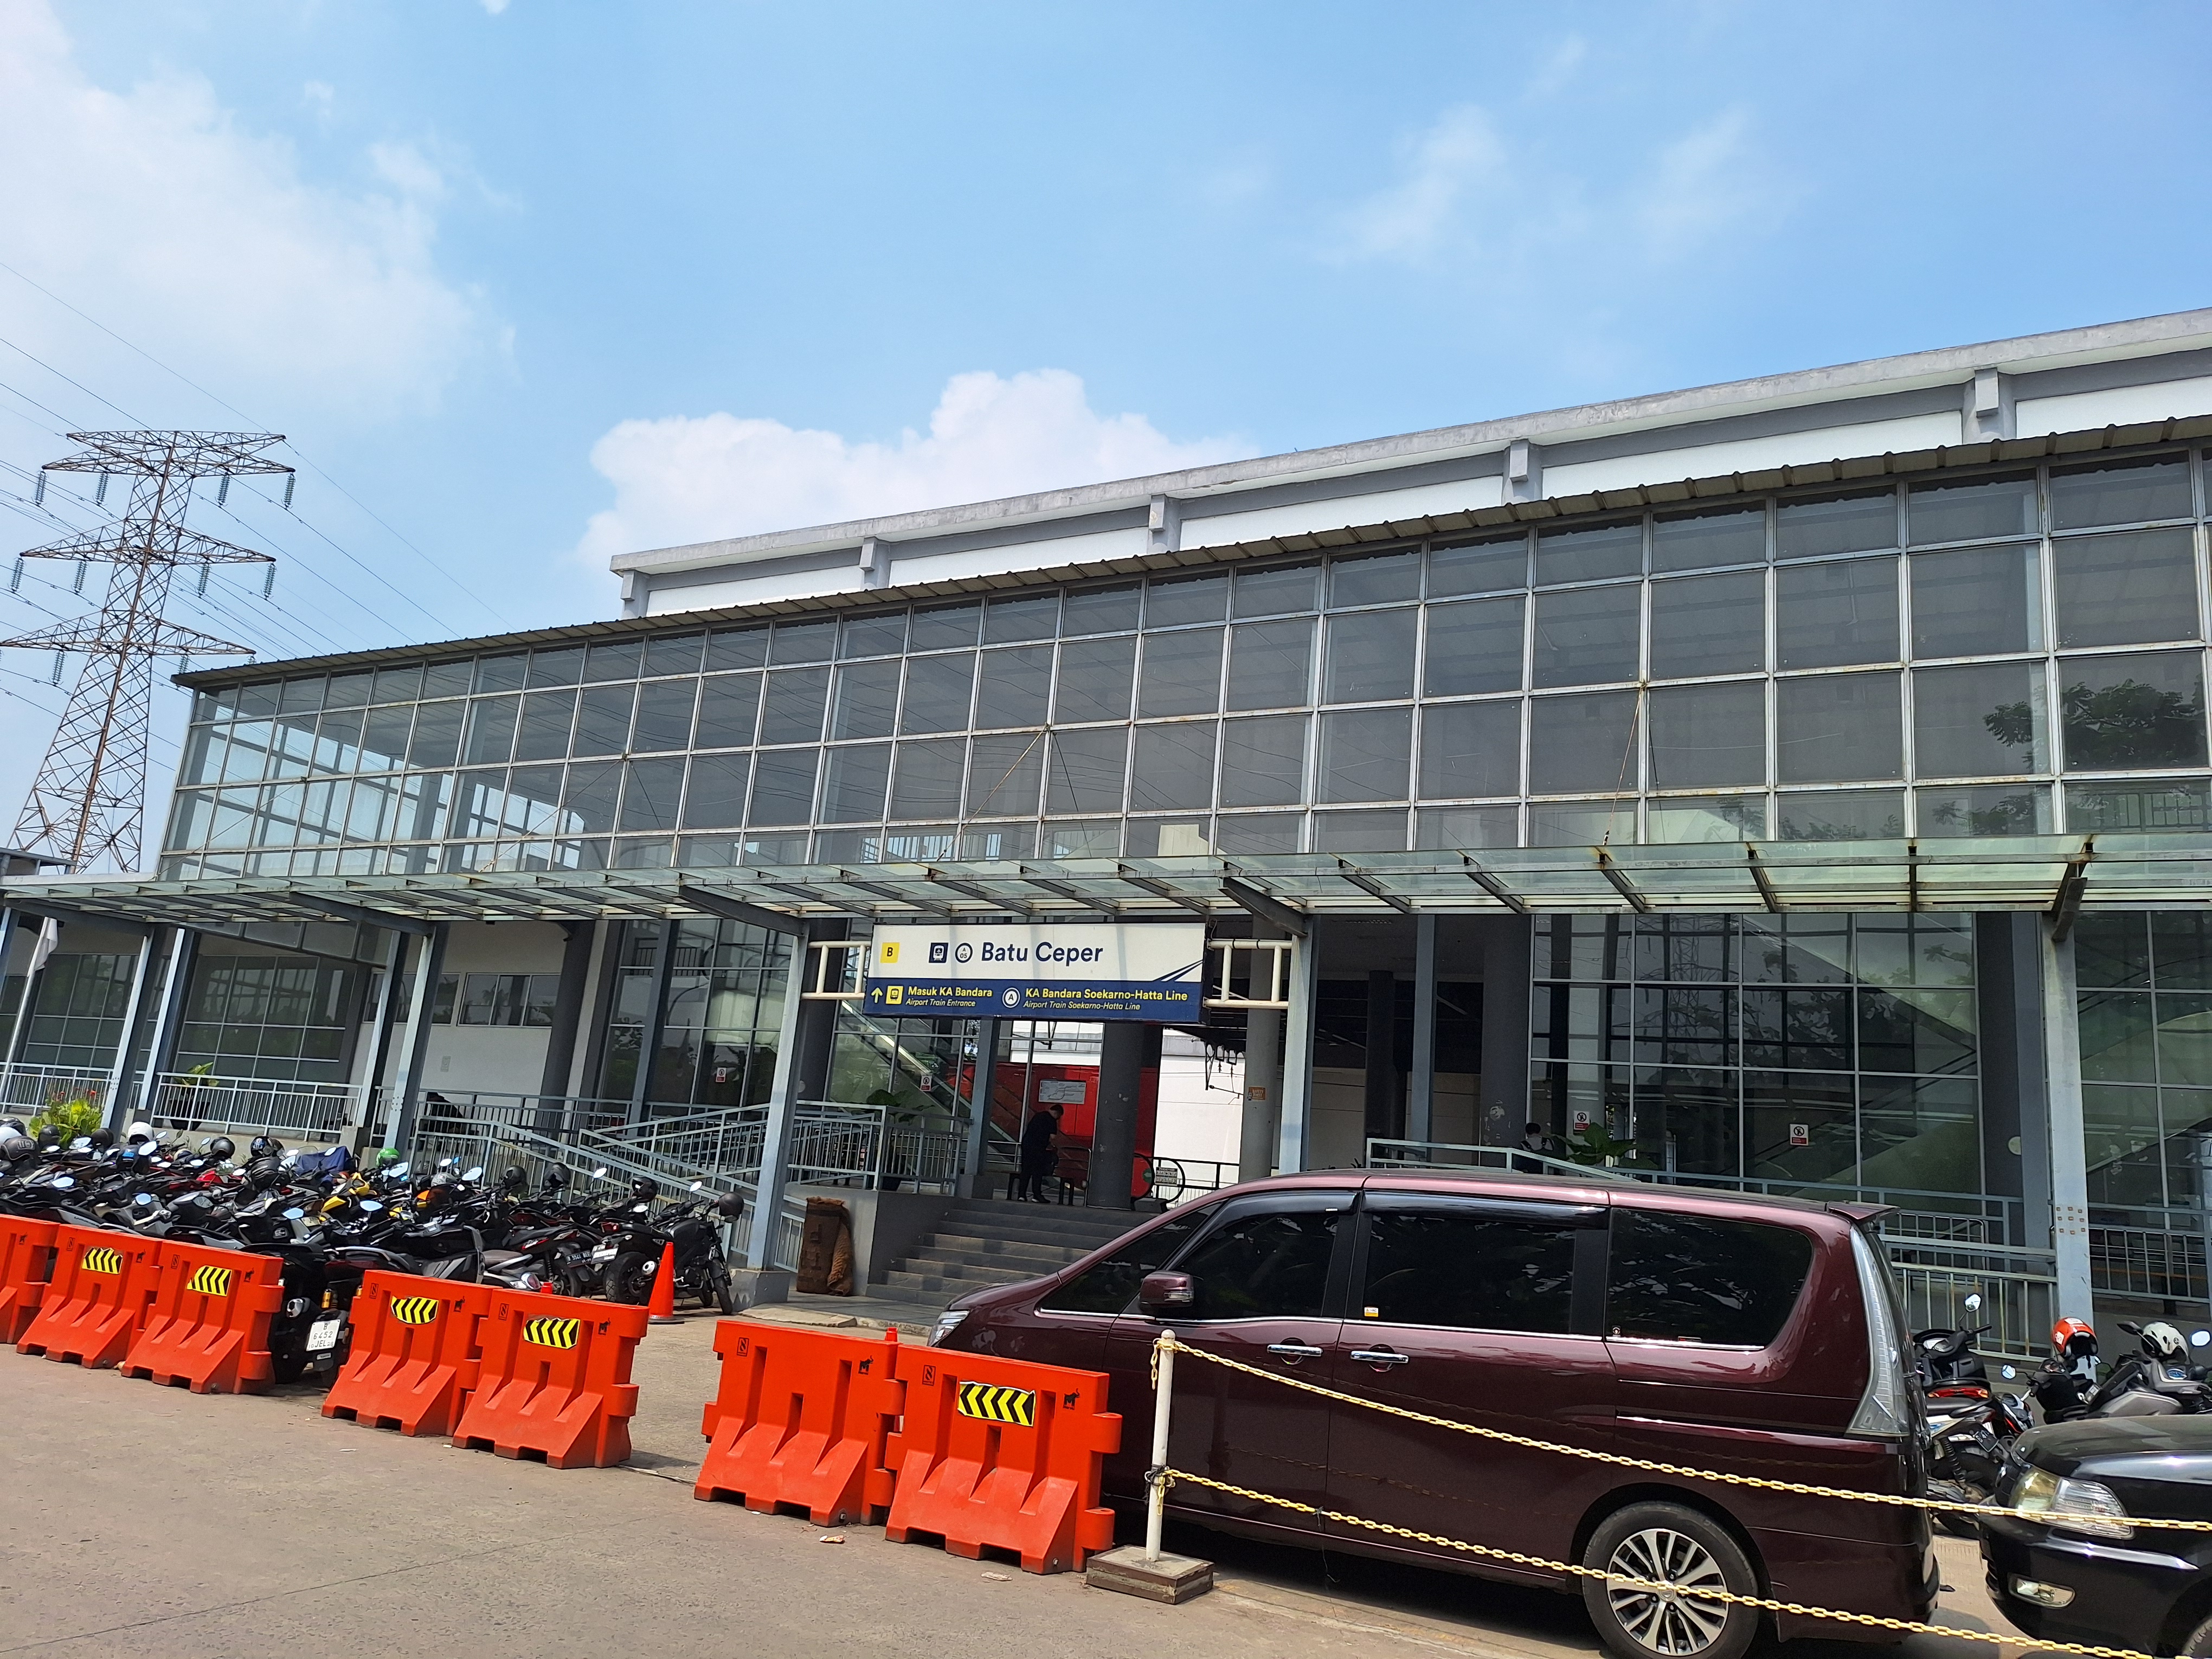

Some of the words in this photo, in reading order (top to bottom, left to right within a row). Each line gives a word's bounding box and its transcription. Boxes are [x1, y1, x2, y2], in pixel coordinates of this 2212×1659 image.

[886, 947, 893, 957] B
[982, 942, 1028, 962] Batu
[1036, 941, 1103, 967] Ceper
[908, 986, 937, 996] Masuk
[939, 987, 953, 996] KA
[955, 987, 992, 997] Bandara
[1025, 988, 1040, 998] KA
[1042, 988, 1082, 999] Bandara
[1084, 989, 1163, 1000] Soekarno-Hatta
[1166, 990, 1188, 1001] Line
[905, 998, 928, 1007] Airport
[929, 999, 946, 1007] Train
[947, 999, 976, 1007] Entrance
[1023, 1000, 1047, 1009] Airport
[1050, 1001, 1066, 1009] Train
[1068, 1001, 1123, 1011] Soekarno-Hatta
[1125, 1002, 1140, 1011] Line
[313, 1331, 333, 1340] 6452
[314, 1340, 326, 1348] JEL
